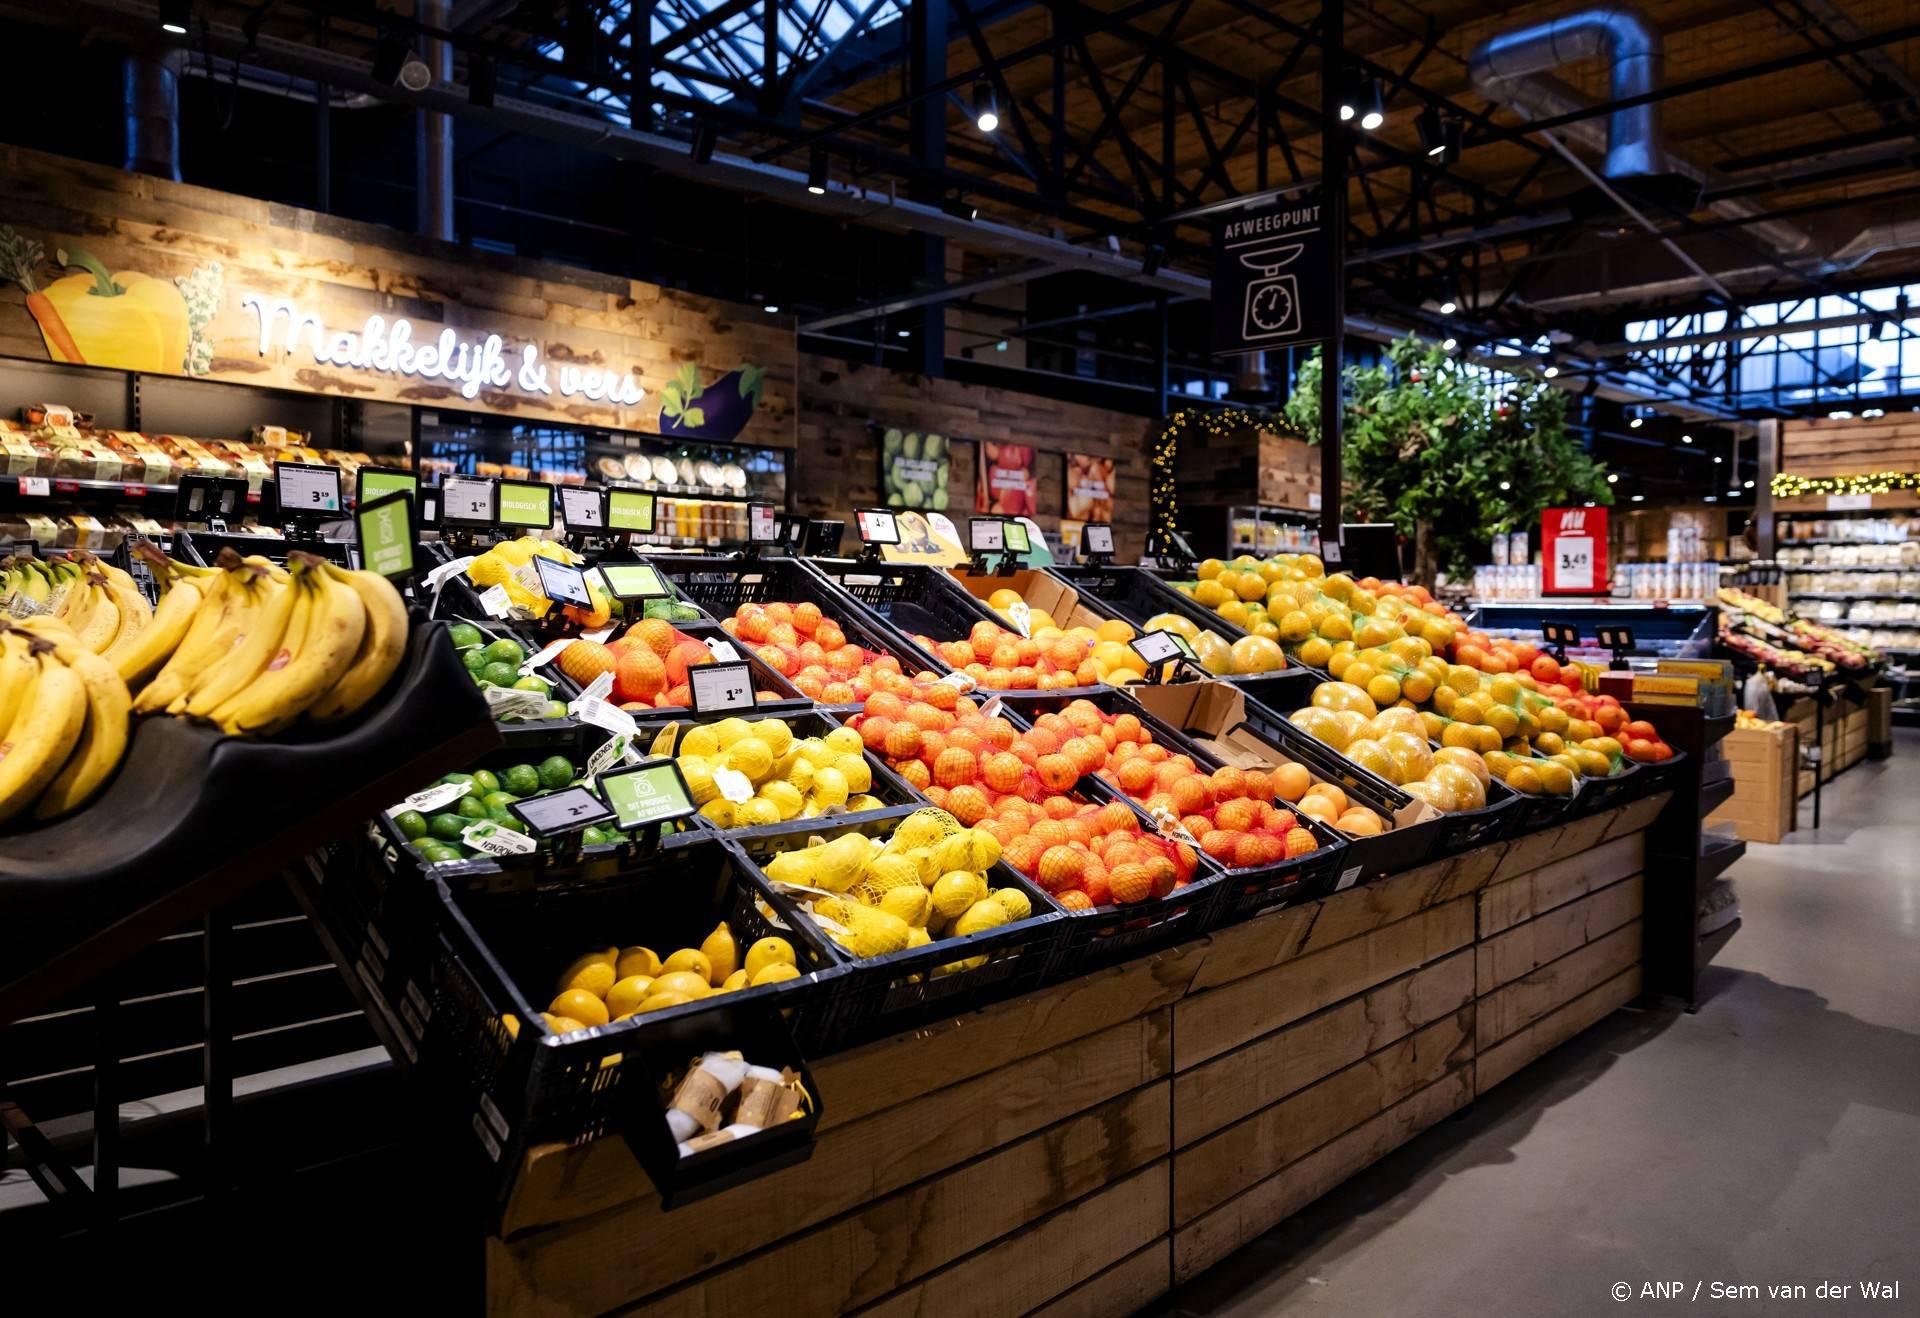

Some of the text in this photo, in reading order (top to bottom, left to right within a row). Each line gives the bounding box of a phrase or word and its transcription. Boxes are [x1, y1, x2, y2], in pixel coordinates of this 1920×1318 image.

[1224, 205, 1321, 240] AFWEEGPUNT
[242, 294, 644, 404] Makkelijk & vers
